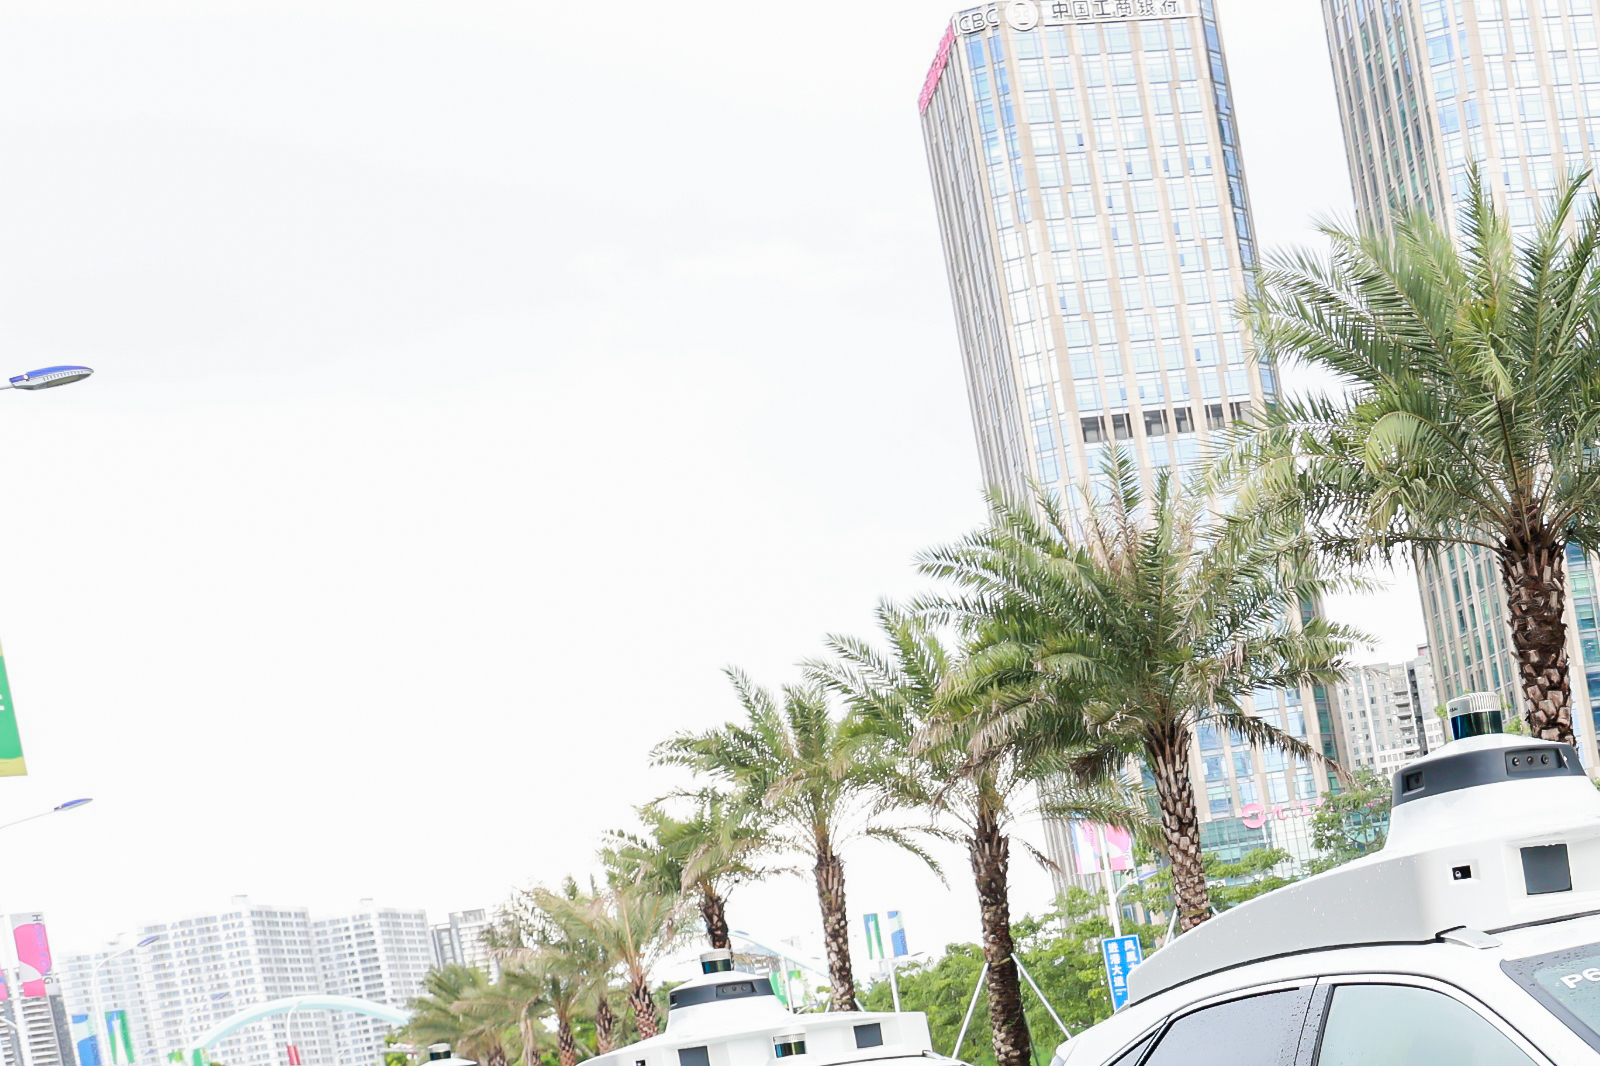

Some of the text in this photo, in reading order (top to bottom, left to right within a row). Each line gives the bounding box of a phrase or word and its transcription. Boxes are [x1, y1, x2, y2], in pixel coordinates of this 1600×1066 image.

[953, 7, 1000, 36] ICBC
[1051, 0, 1178, 20] 中国工商银行
